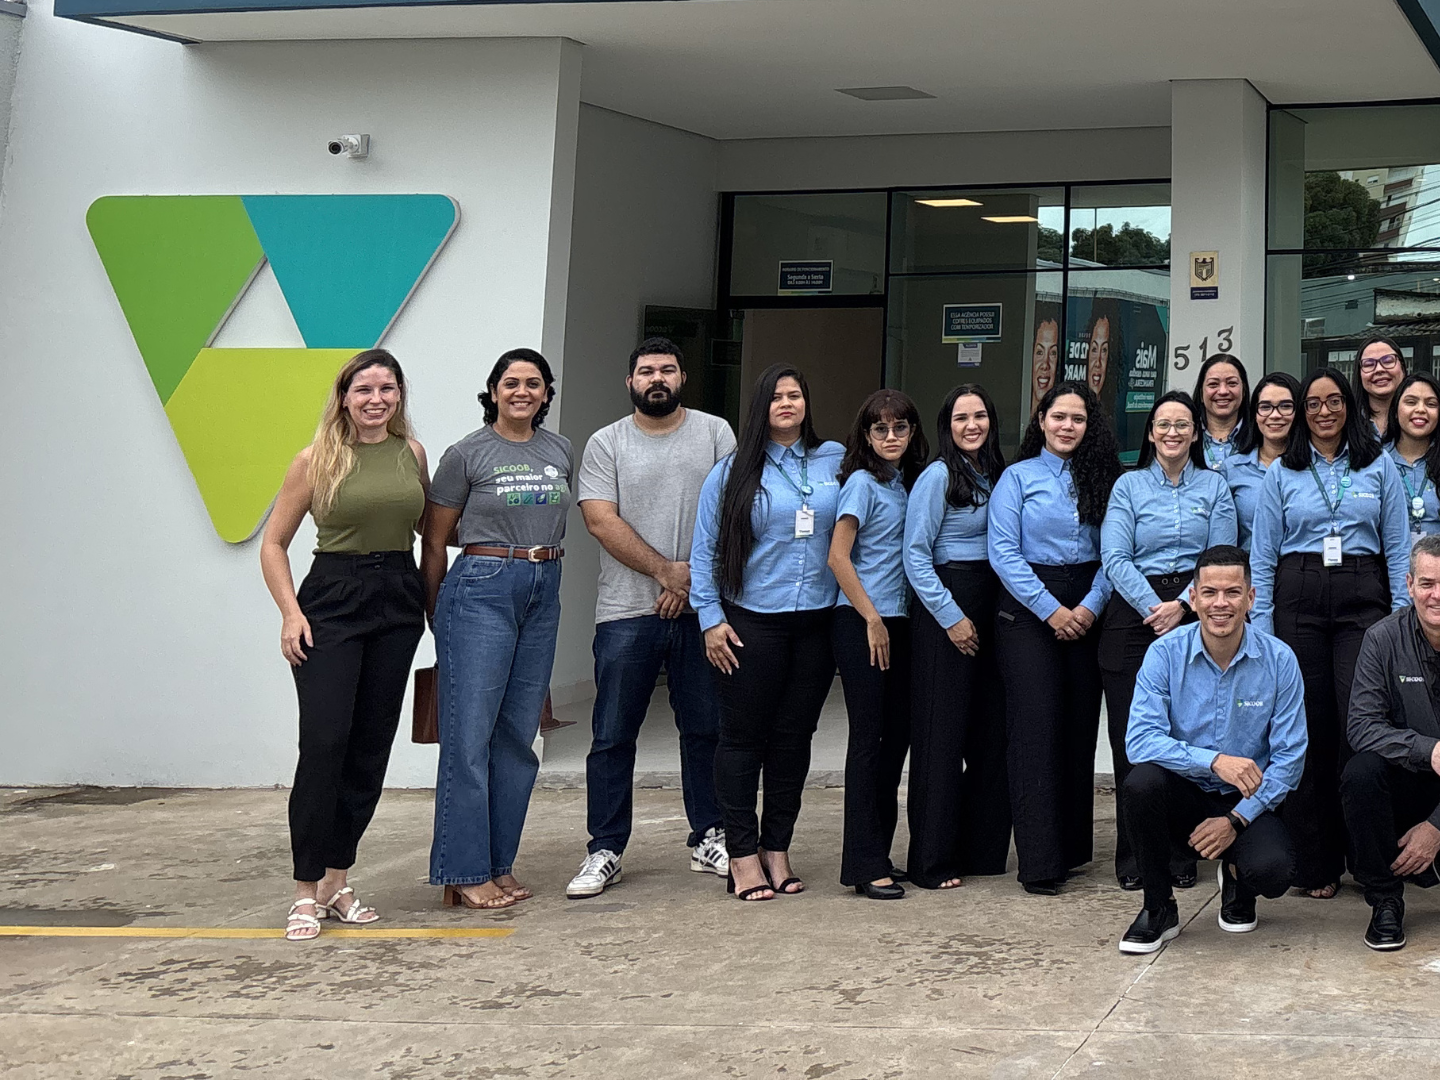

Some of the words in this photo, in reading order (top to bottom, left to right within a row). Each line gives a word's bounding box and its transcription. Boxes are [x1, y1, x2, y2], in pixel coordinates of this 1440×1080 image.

[1173, 325, 1234, 371] 513
[495, 475, 514, 484] seu
[515, 473, 543, 482] maior
[496, 483, 540, 496] parceiro
